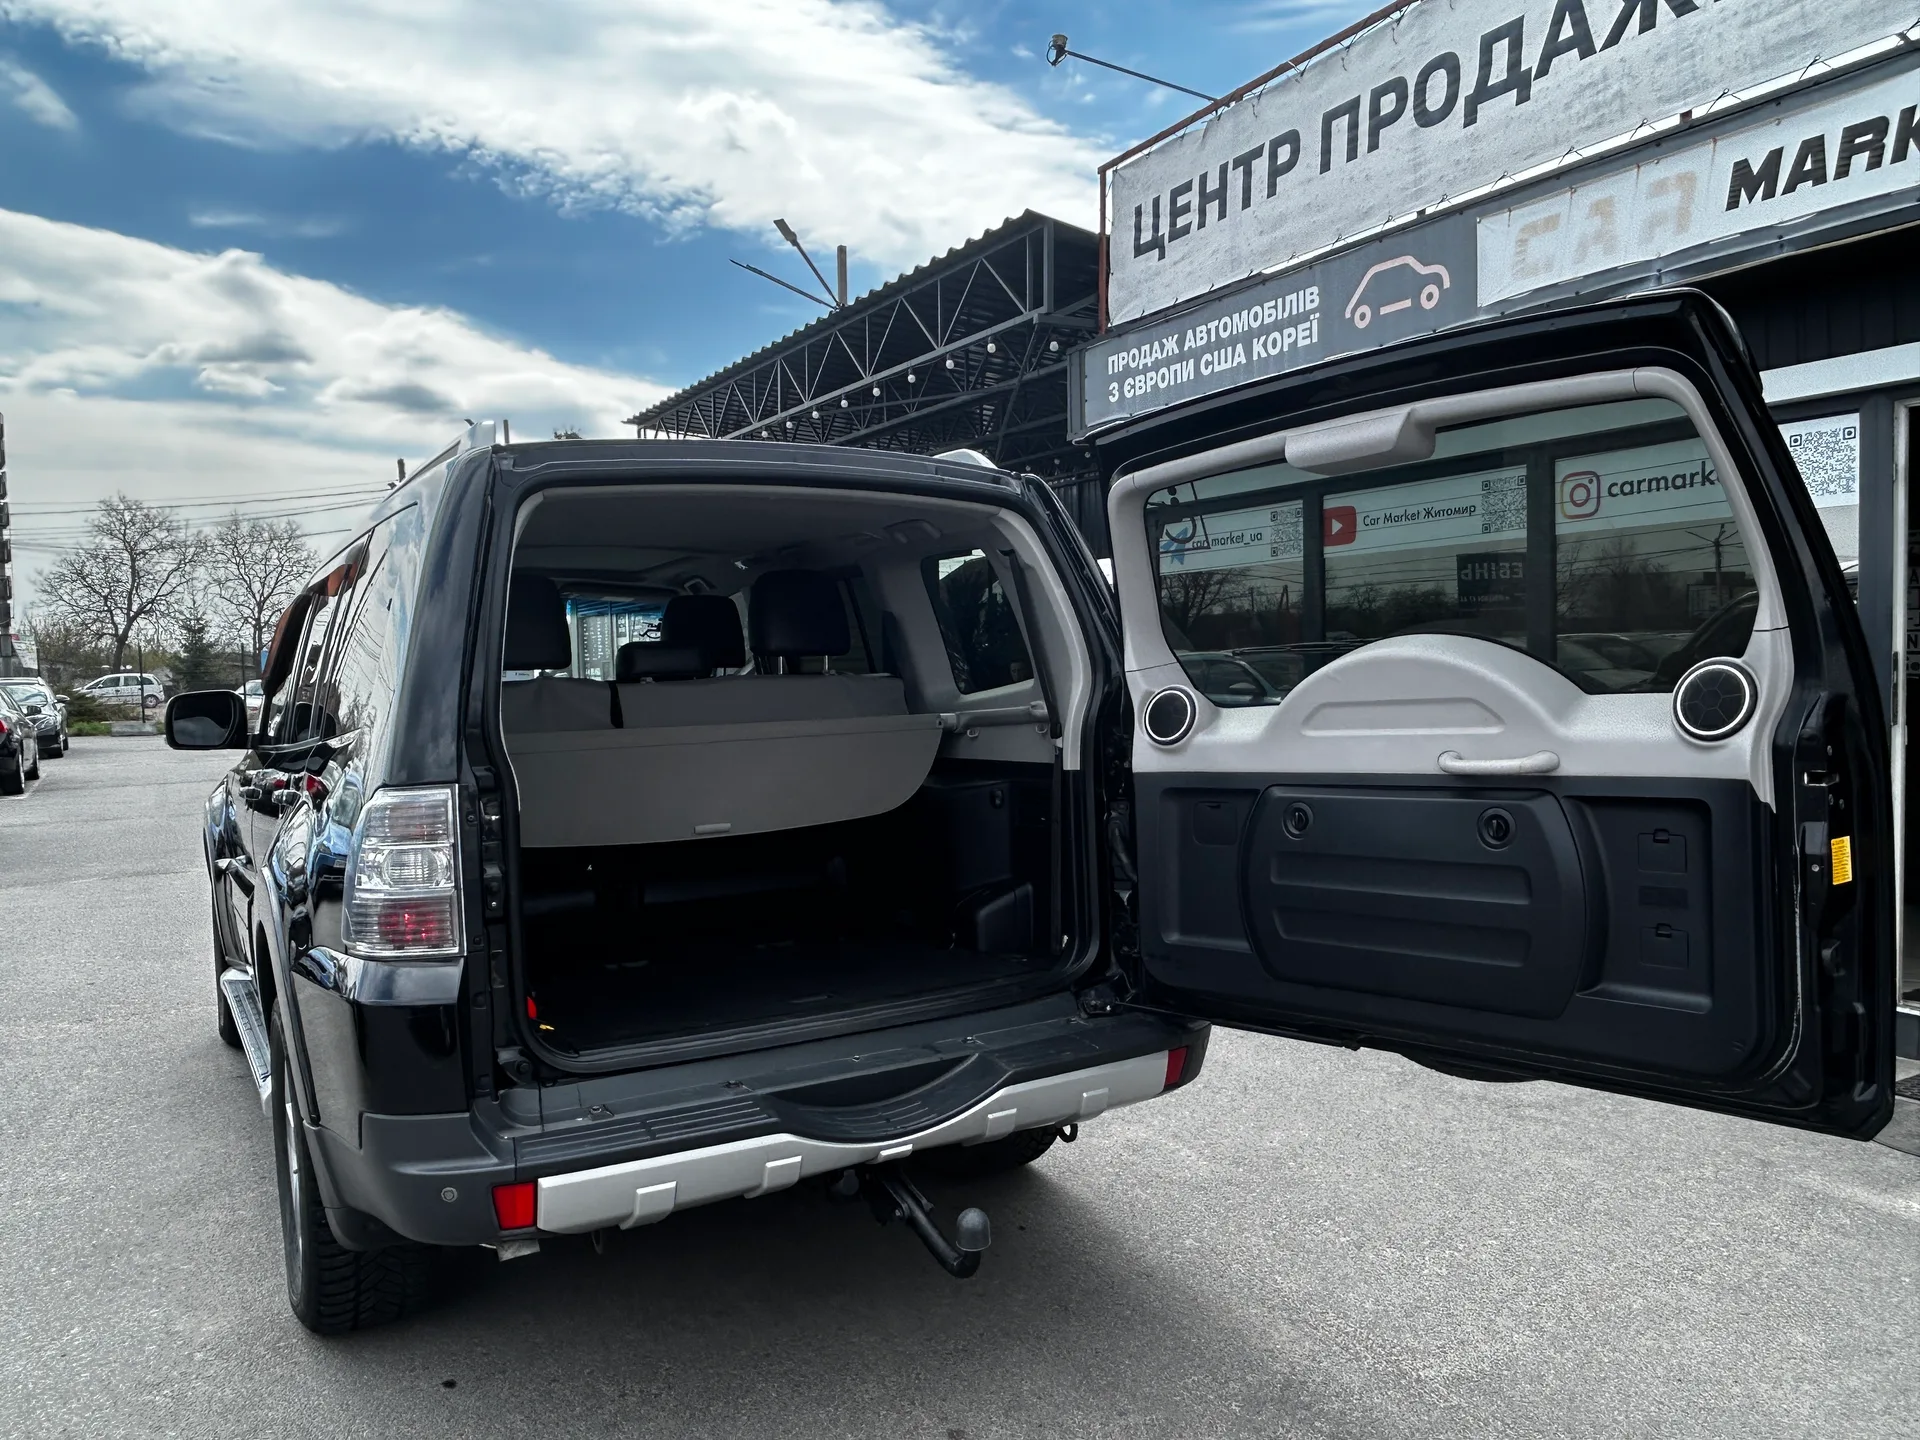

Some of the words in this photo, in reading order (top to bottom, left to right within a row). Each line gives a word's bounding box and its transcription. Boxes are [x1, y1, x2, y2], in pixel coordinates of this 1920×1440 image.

[1133, 128, 1301, 262] ЦЕНТР
[1319, 0, 1720, 175] ПРОДА
[1107, 334, 1180, 375] ПРОДАЖ
[1183, 285, 1320, 352] АВТОМОБІЛІВ
[1123, 358, 1195, 398] ЄВРОПИ
[1200, 343, 1247, 376] США
[1252, 313, 1320, 361] КОРЕЇ
[1363, 514, 1381, 527] Car
[1383, 508, 1420, 525] Market
[1423, 504, 1477, 519] Житомир
[1607, 460, 1717, 498] carmark
